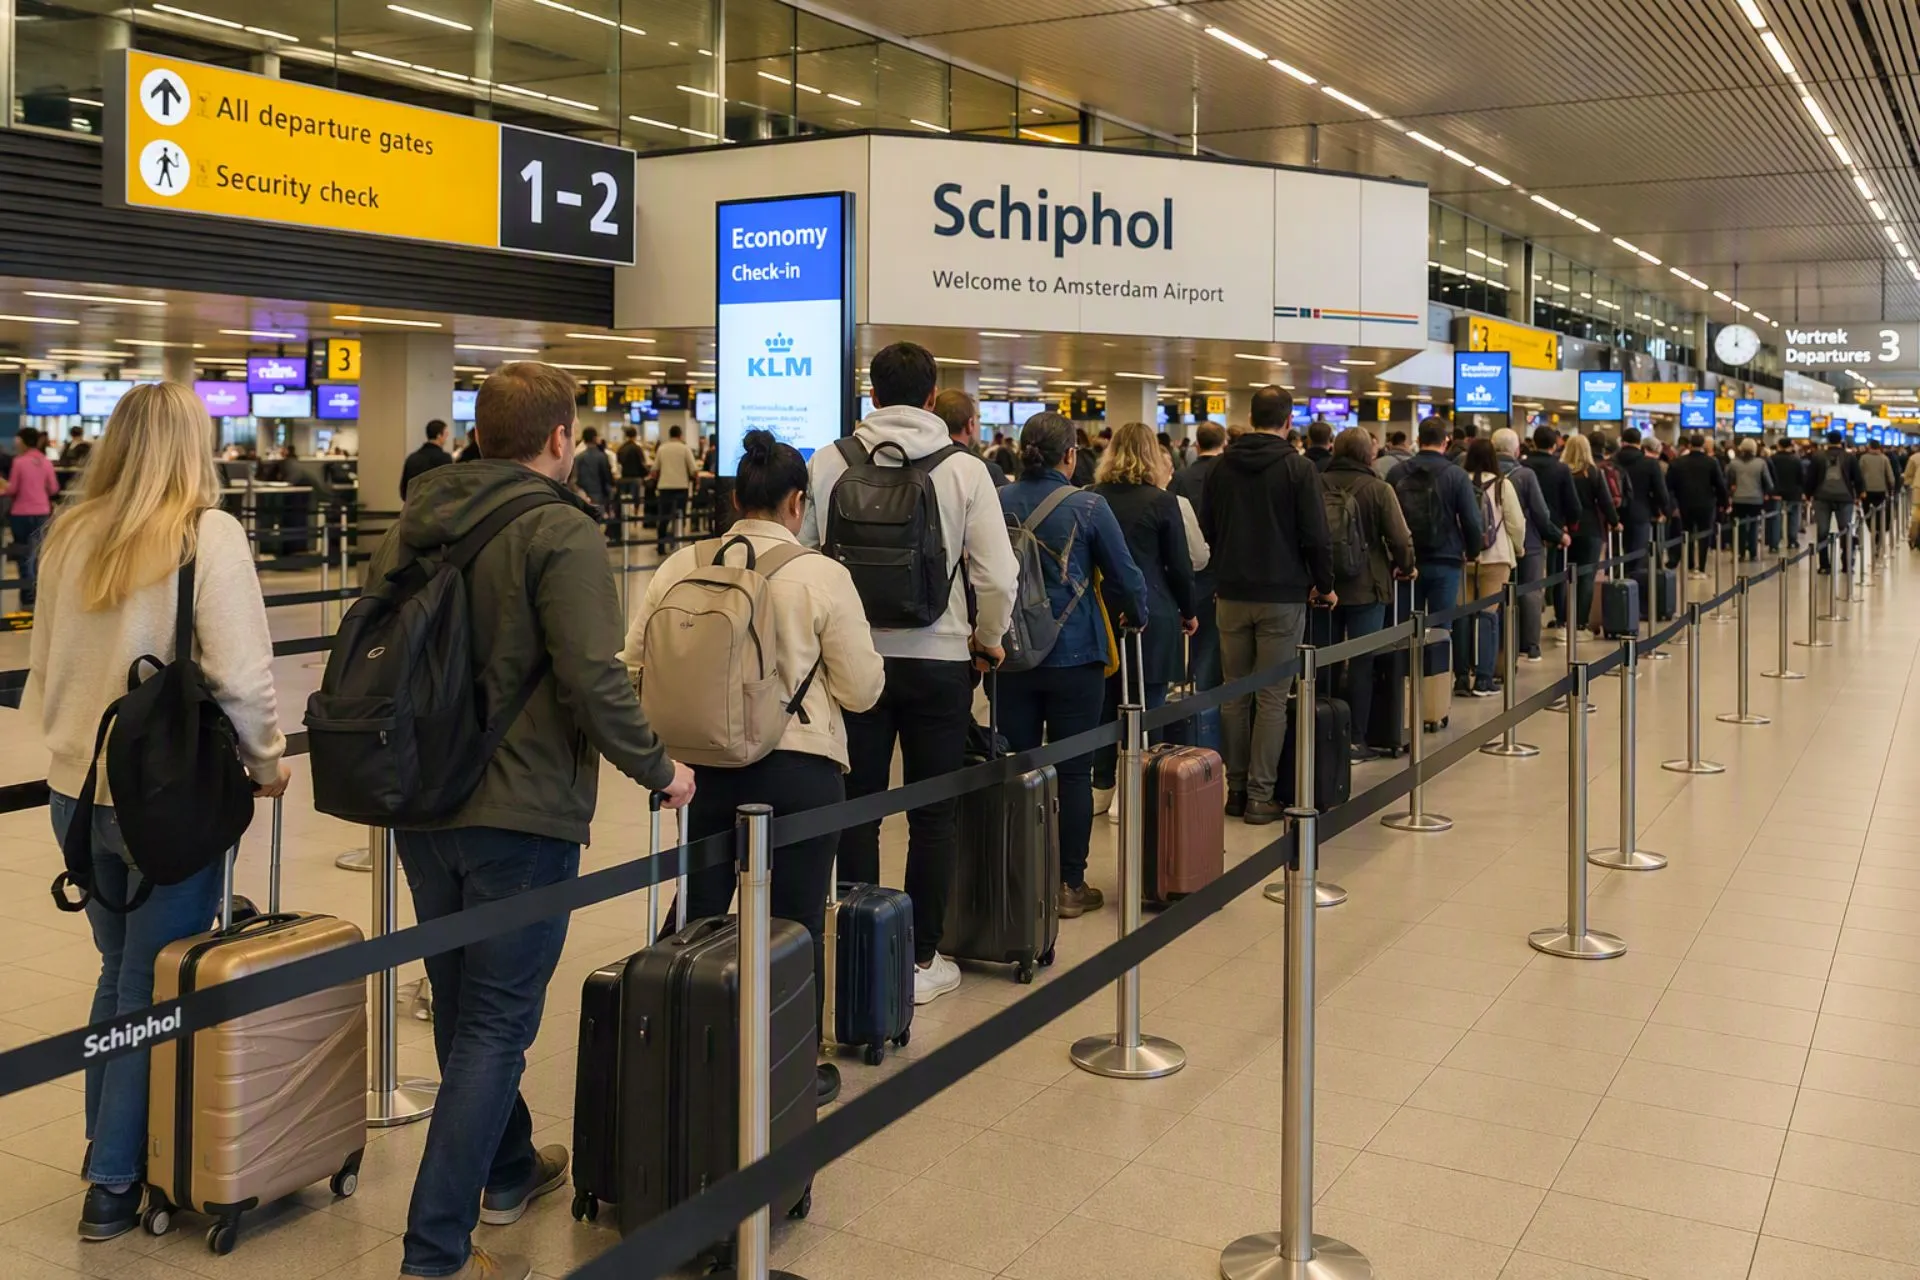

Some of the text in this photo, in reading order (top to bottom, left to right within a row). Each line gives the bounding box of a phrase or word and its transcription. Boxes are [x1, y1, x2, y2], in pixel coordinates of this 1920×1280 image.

[216, 96, 434, 156] All departure gates
[216, 164, 379, 209] Security check
[519, 159, 620, 236] 1-2
[932, 182, 1174, 258] Schiphol
[731, 227, 828, 250] Economy
[731, 262, 801, 282] Check-in
[932, 270, 1225, 305] Welcome to Amsterdam Airport
[1785, 328, 1848, 345] Vertrek
[1877, 329, 1901, 362] 3
[338, 347, 351, 371] 3
[747, 356, 812, 377] KLM
[1785, 348, 1871, 366] Departures
[83, 1006, 182, 1058] Schiphol
